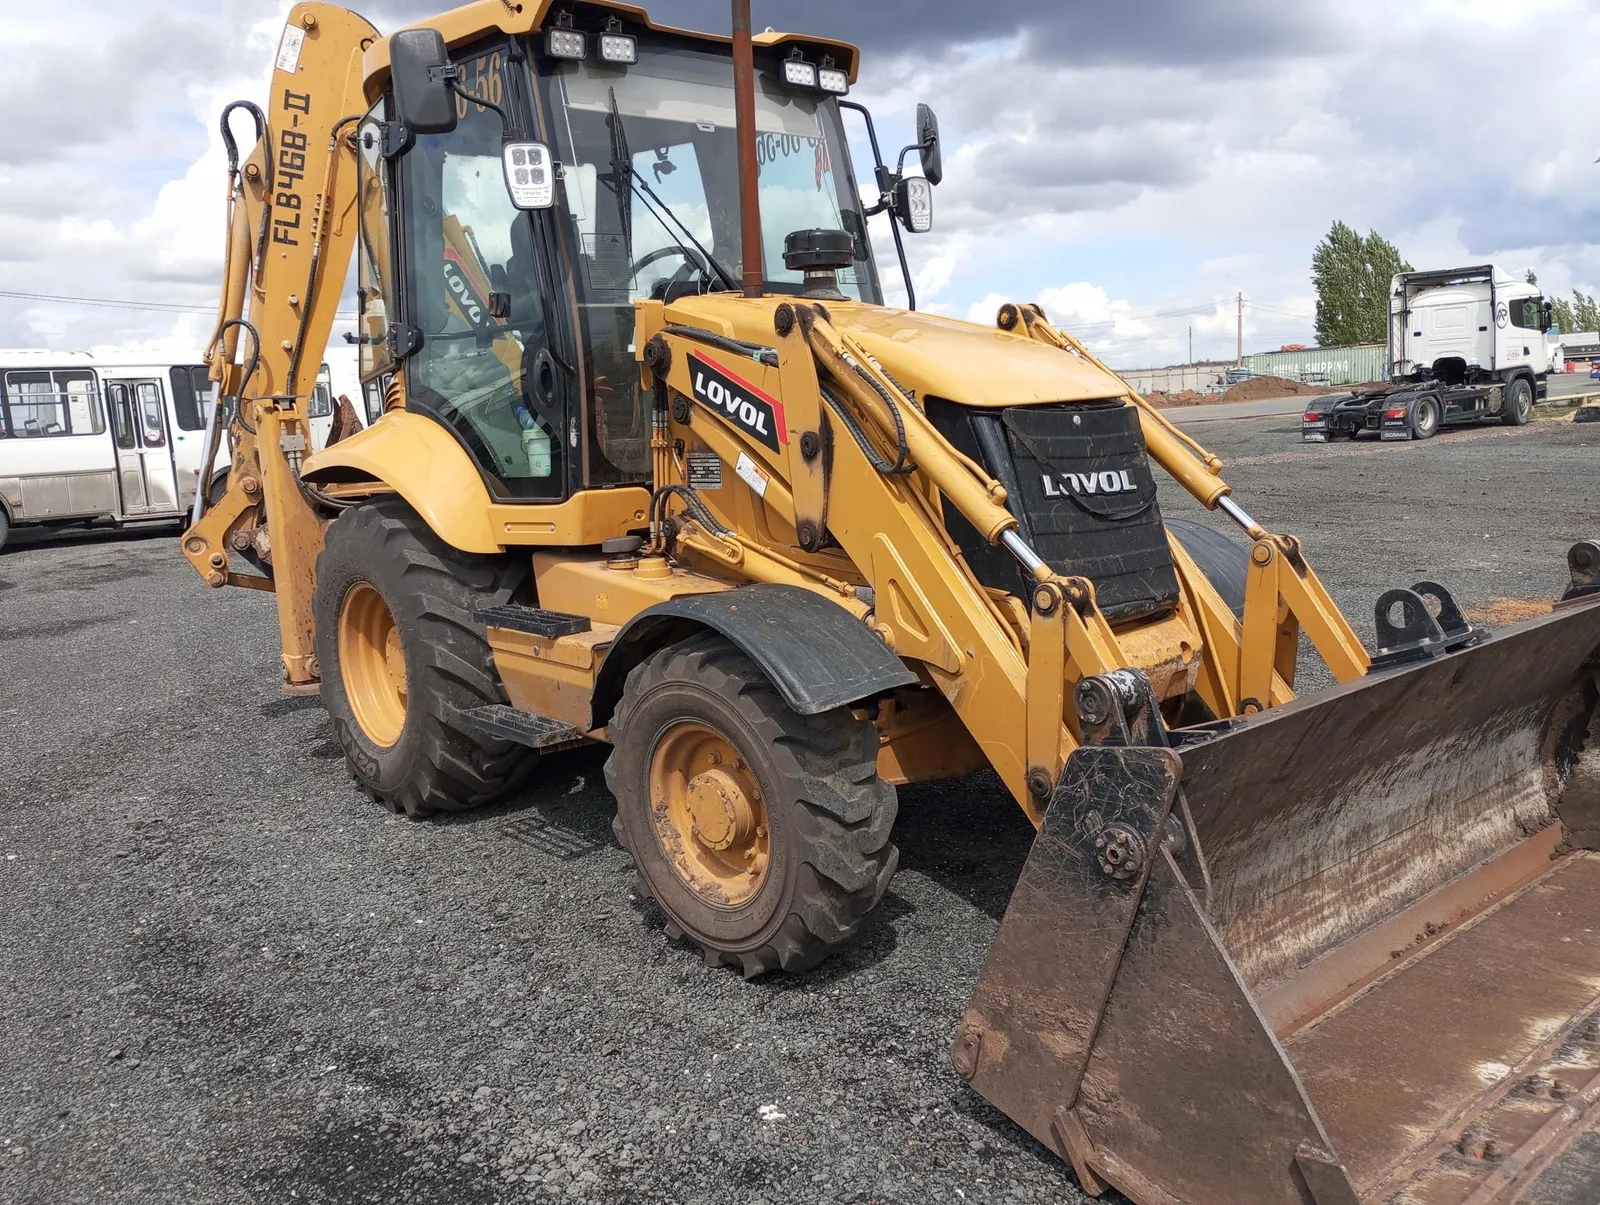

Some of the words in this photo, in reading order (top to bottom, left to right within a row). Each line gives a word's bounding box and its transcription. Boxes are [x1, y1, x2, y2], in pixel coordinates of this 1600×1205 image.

[443, 263, 490, 327] LOVO
[1273, 363, 1299, 377] CHINA
[1305, 360, 1348, 373] SHIPPING
[695, 371, 768, 436] LOVOL
[1042, 470, 1138, 497] LOVOL
